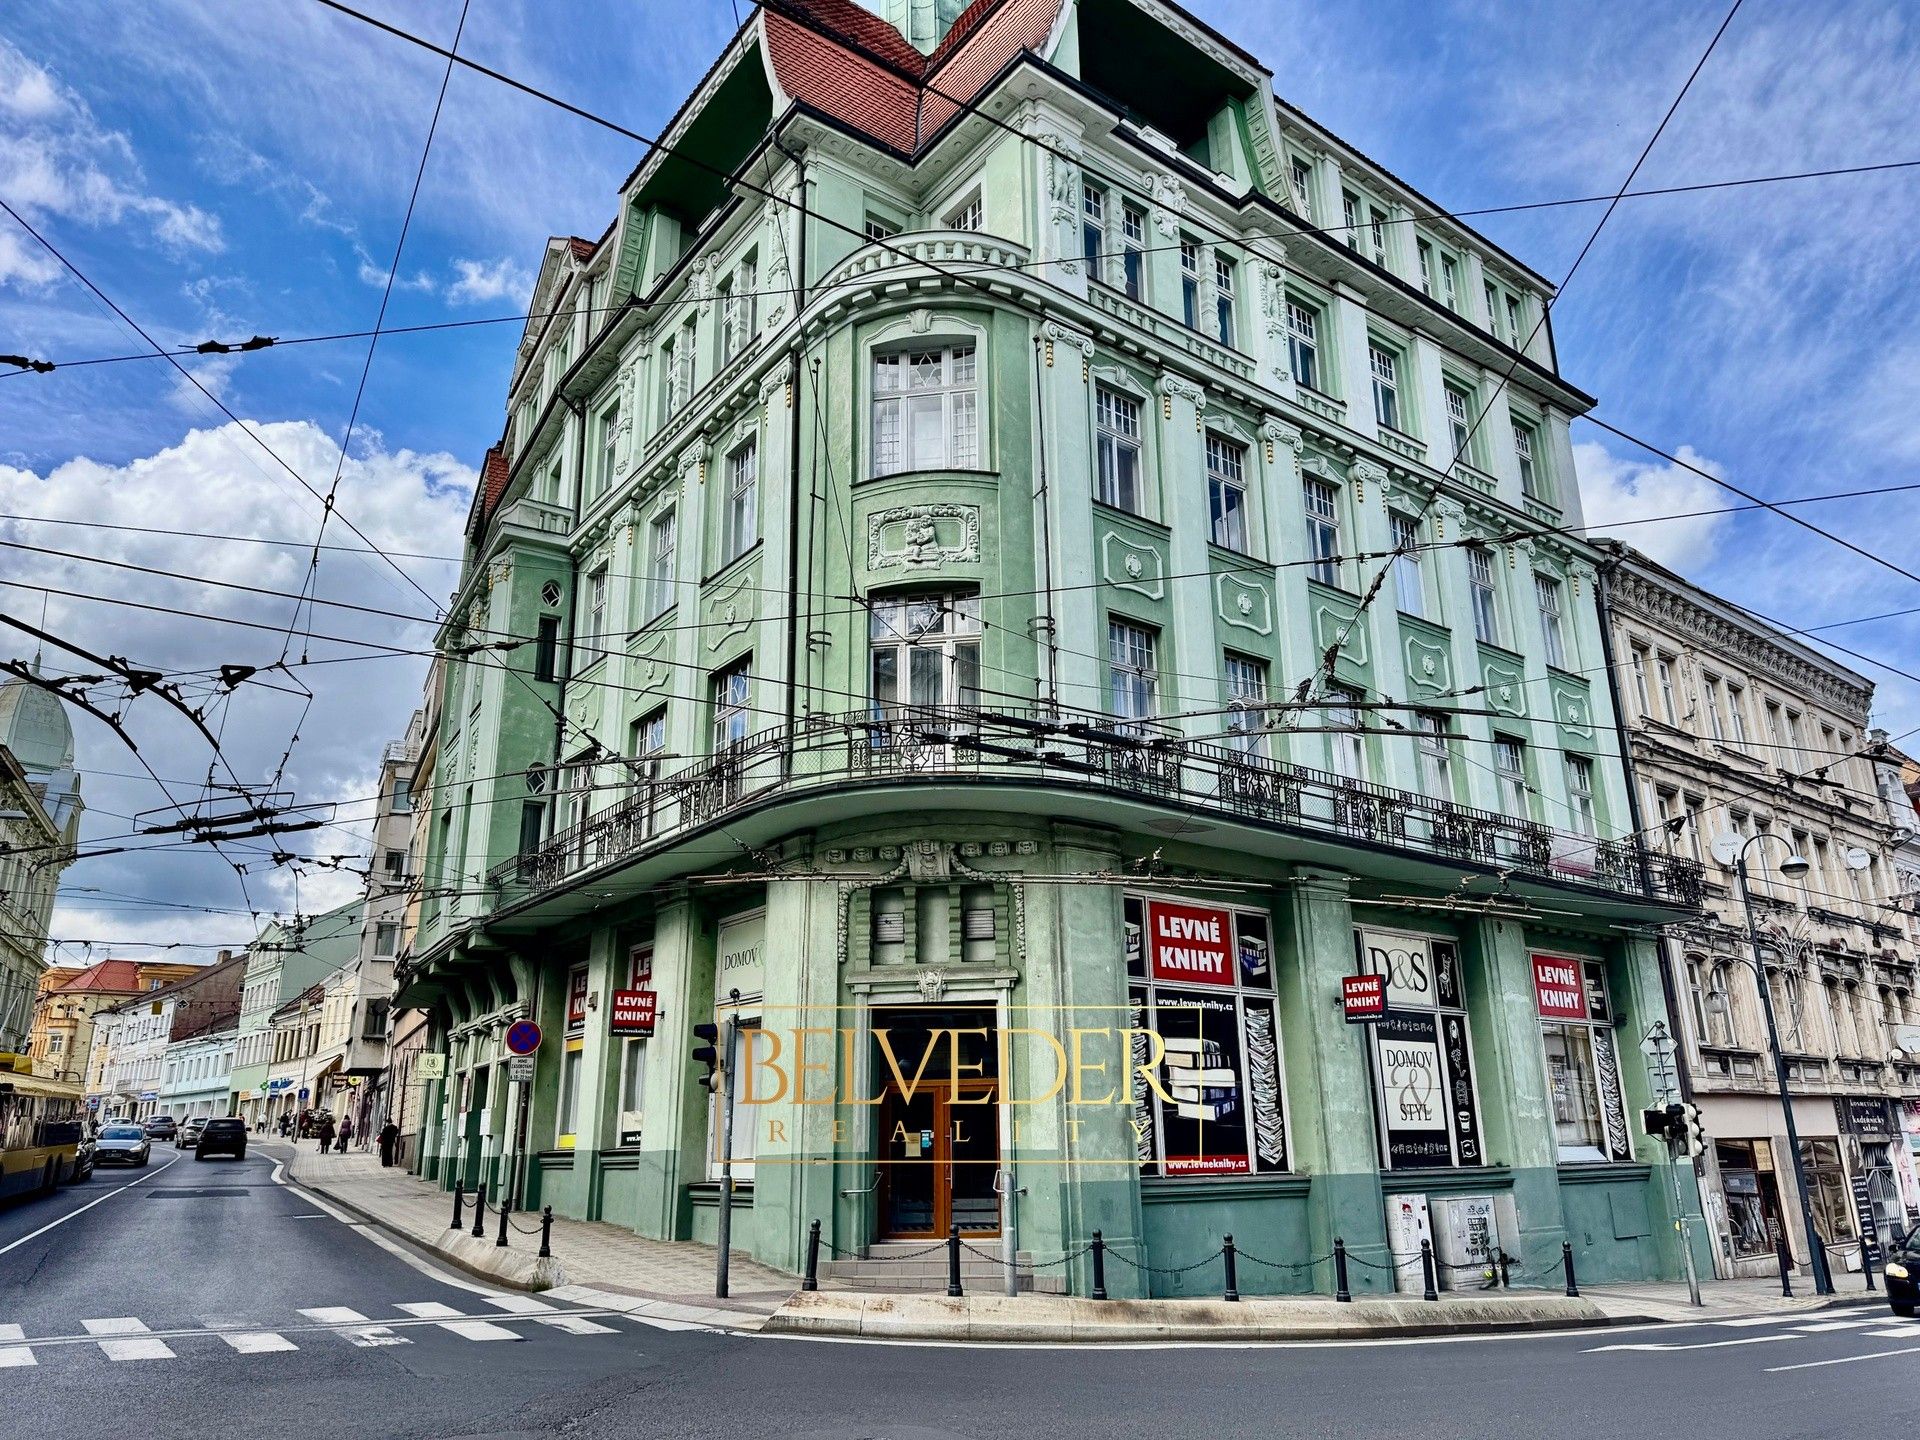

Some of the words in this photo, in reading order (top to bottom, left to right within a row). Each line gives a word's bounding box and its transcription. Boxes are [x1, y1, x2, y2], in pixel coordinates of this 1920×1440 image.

[1158, 914, 1221, 944] LEVNÉ
[1159, 945, 1224, 974] KNIHY
[1537, 964, 1577, 986] LEVNÉ
[1345, 978, 1379, 993] LEVNÉ
[616, 994, 653, 1007] LEVNÉ
[1157, 997, 1234, 1012] www.levneknihy.cz
[1345, 995, 1381, 1008] KNIHY
[1540, 988, 1580, 1009] KNIHY
[614, 1010, 653, 1022] KNIHY
[1386, 1049, 1433, 1069] DOMOV
[1400, 1103, 1432, 1121] STYL
[1167, 1158, 1247, 1170] www.levneknihy.cz
